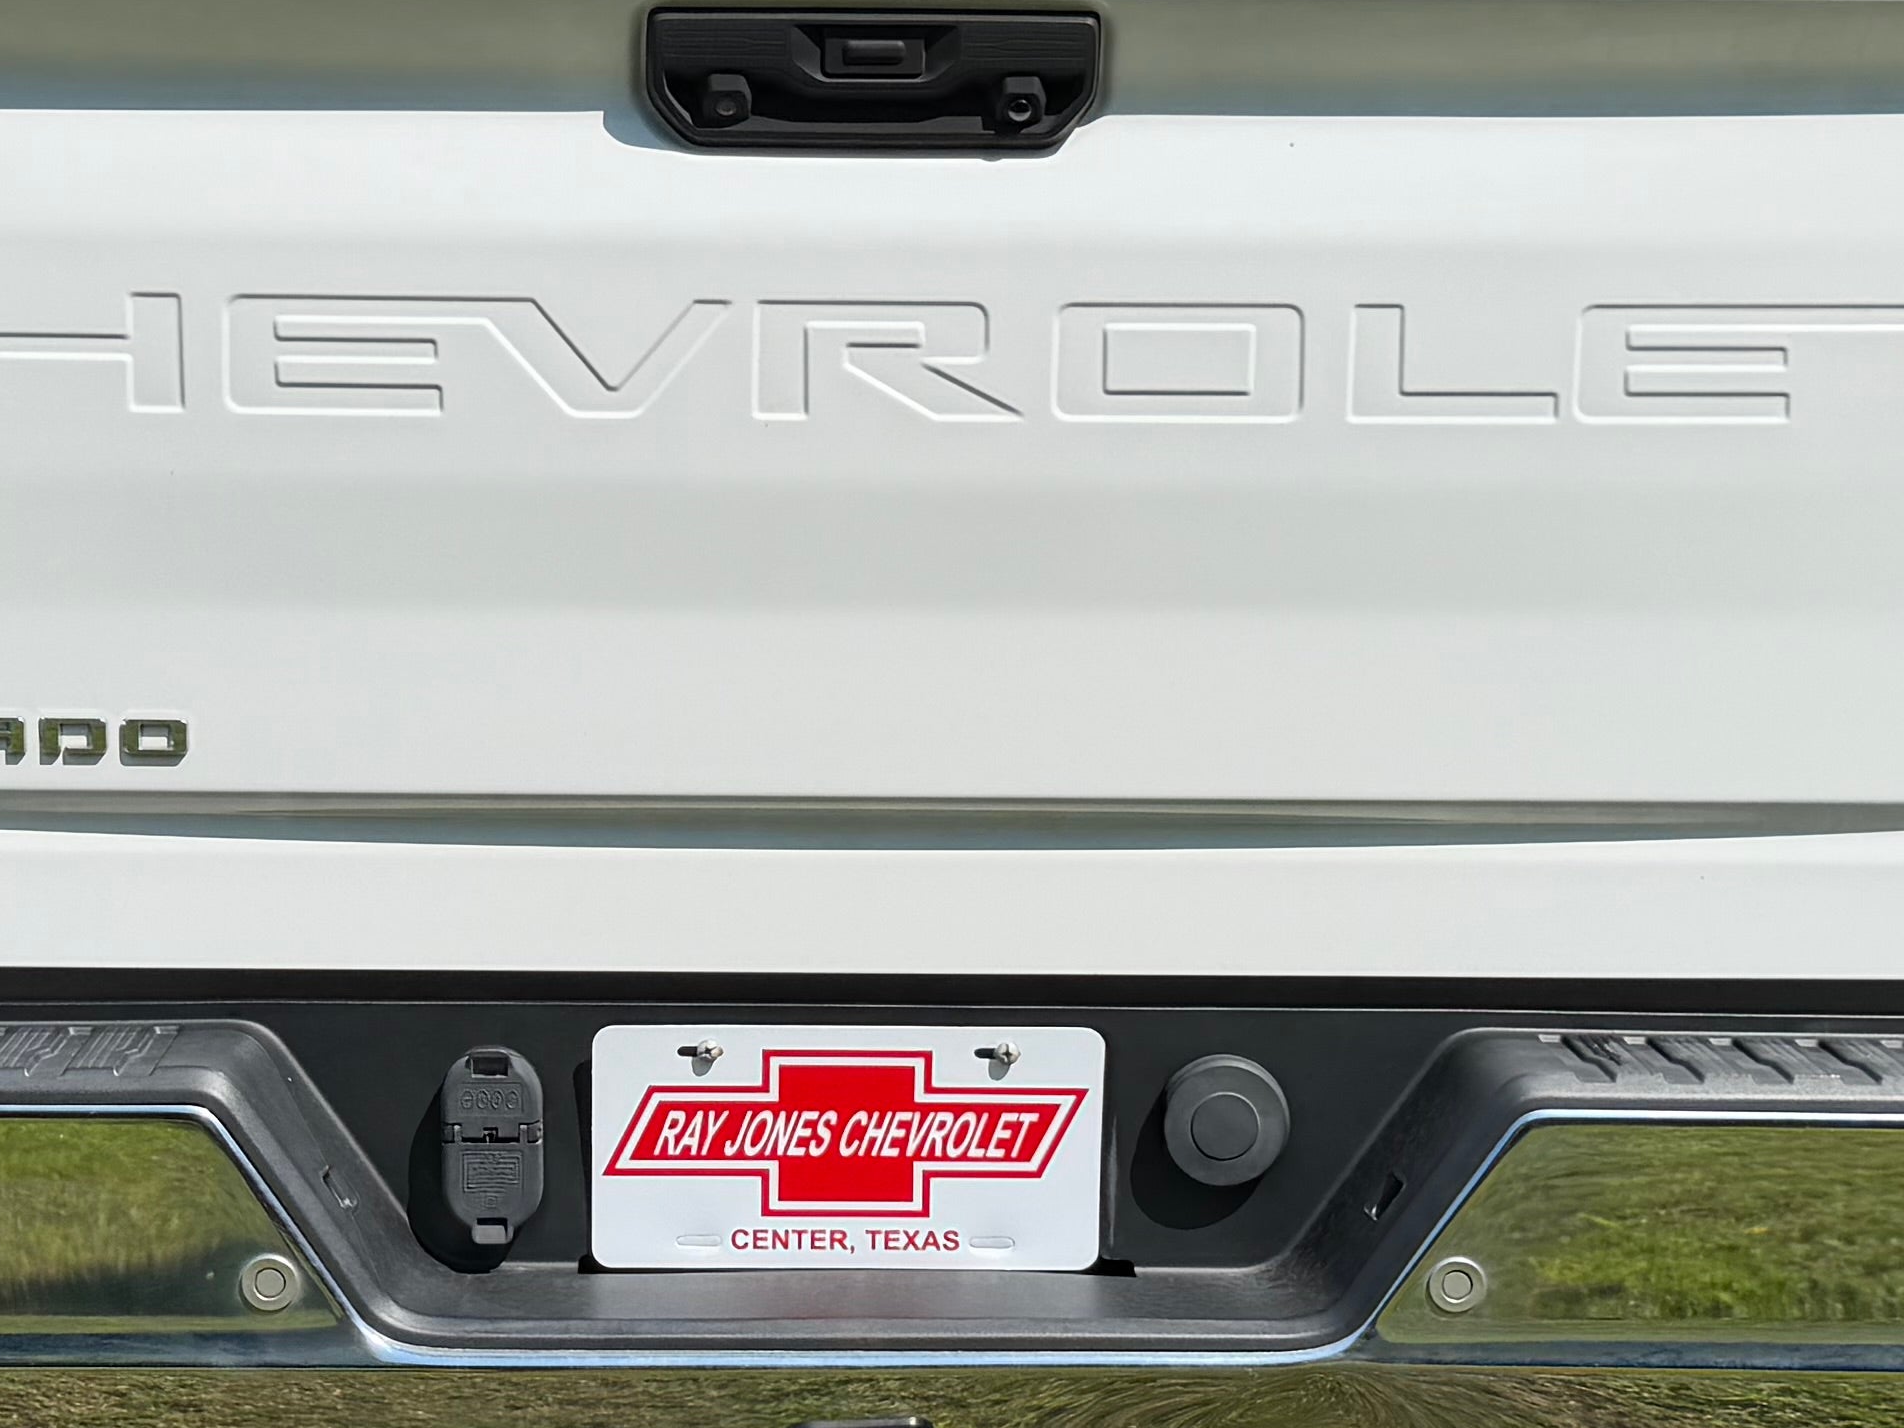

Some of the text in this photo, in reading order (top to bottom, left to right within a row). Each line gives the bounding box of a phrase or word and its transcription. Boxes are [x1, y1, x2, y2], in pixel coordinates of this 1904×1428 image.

[653, 1109, 1040, 1159] RAY JONES CHEVROLET
[730, 1228, 960, 1254] CENTER, TEXAS
